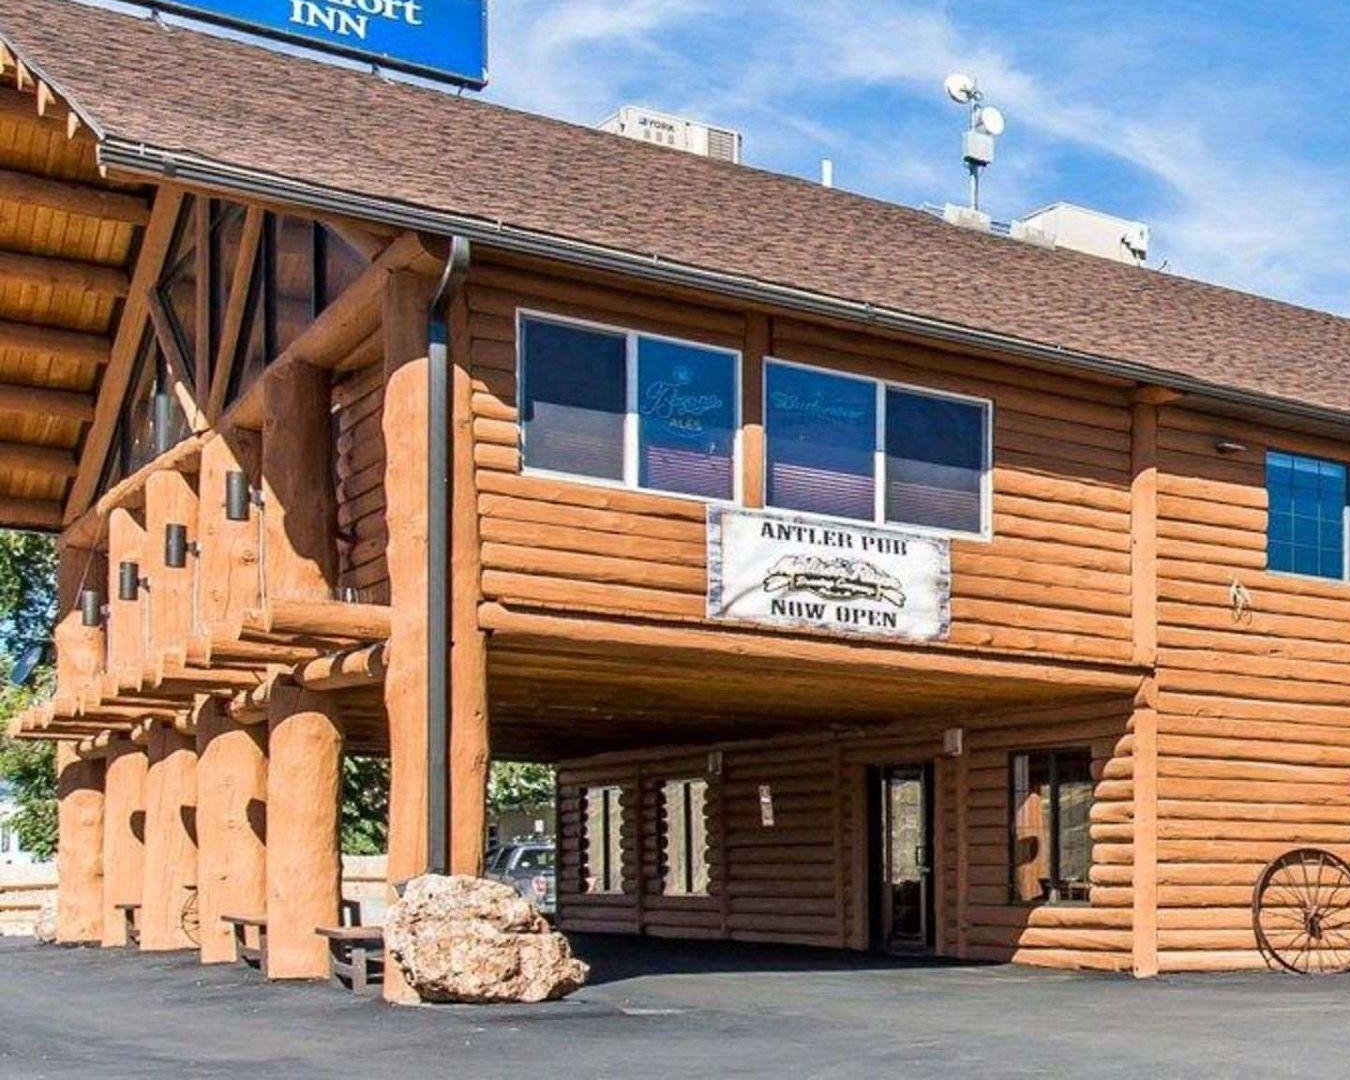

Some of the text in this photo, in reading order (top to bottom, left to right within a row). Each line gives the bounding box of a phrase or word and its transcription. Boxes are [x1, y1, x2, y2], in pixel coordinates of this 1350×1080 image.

[761, 521, 907, 556] ANTLER PUB
[771, 599, 898, 628] NOW OPEN
